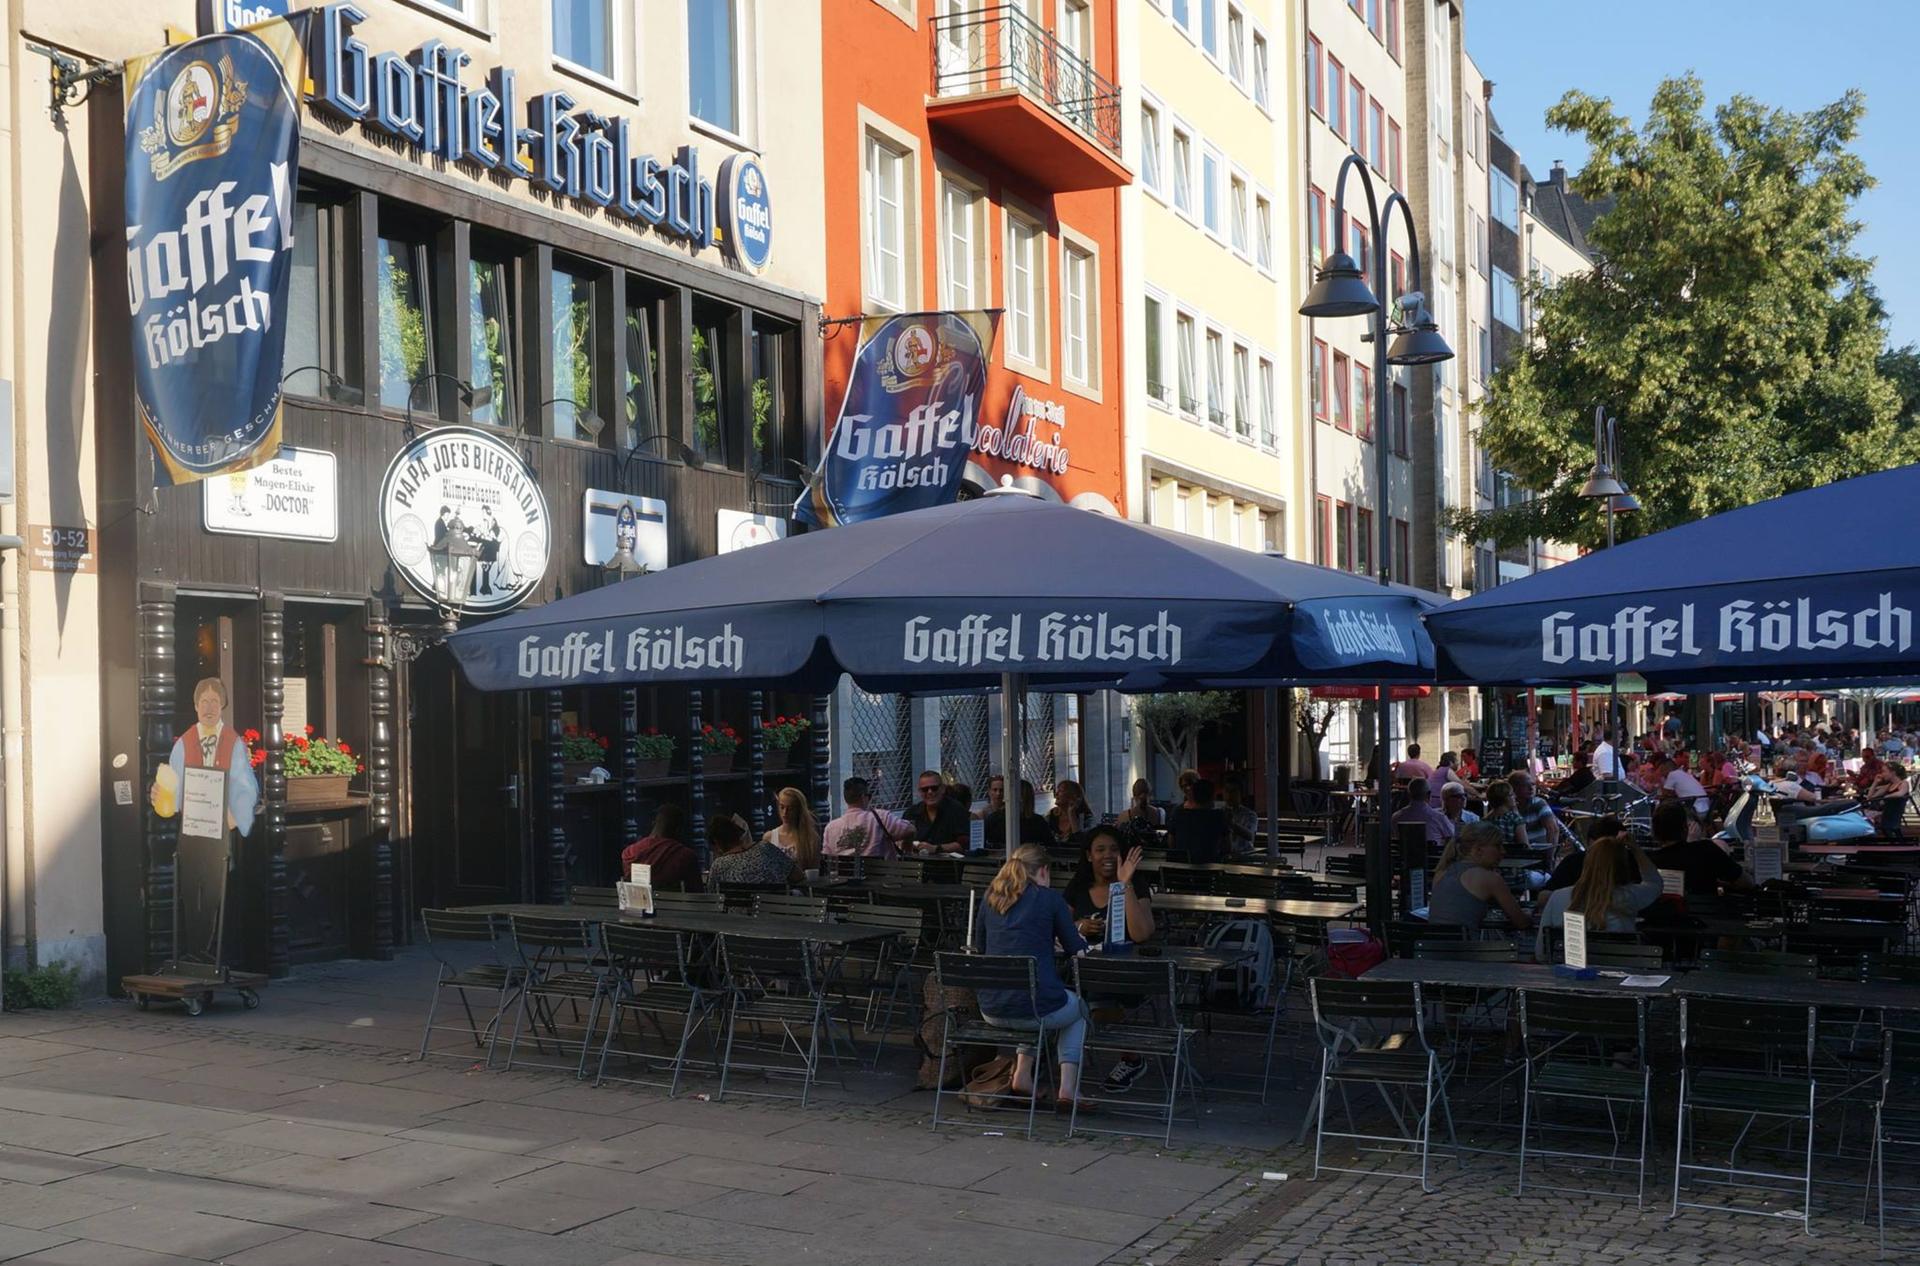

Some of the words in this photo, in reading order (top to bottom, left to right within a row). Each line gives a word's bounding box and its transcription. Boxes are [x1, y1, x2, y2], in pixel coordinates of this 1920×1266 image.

[738, 198, 770, 230] Gaffel
[144, 276, 271, 369] Kölsch
[836, 393, 975, 462] Gaffel
[254, 476, 315, 493] Magen-Elixir
[272, 463, 303, 477] Bestes
[395, 456, 431, 508] PAPA
[433, 443, 470, 473] JOE'S
[473, 445, 539, 525] BIERSALON
[442, 477, 501, 505] Klimperkasten
[857, 456, 949, 491] Kölsch
[42, 527, 85, 548] 50-52
[518, 629, 616, 680] Gaffel
[625, 622, 744, 673] Kölsch
[903, 613, 1025, 667] Gaffel
[1037, 609, 1182, 666] Kölsch
[1323, 608, 1376, 657] Gaffel
[1541, 602, 1702, 665] Gaffel
[1718, 591, 1912, 653] Kölsch
